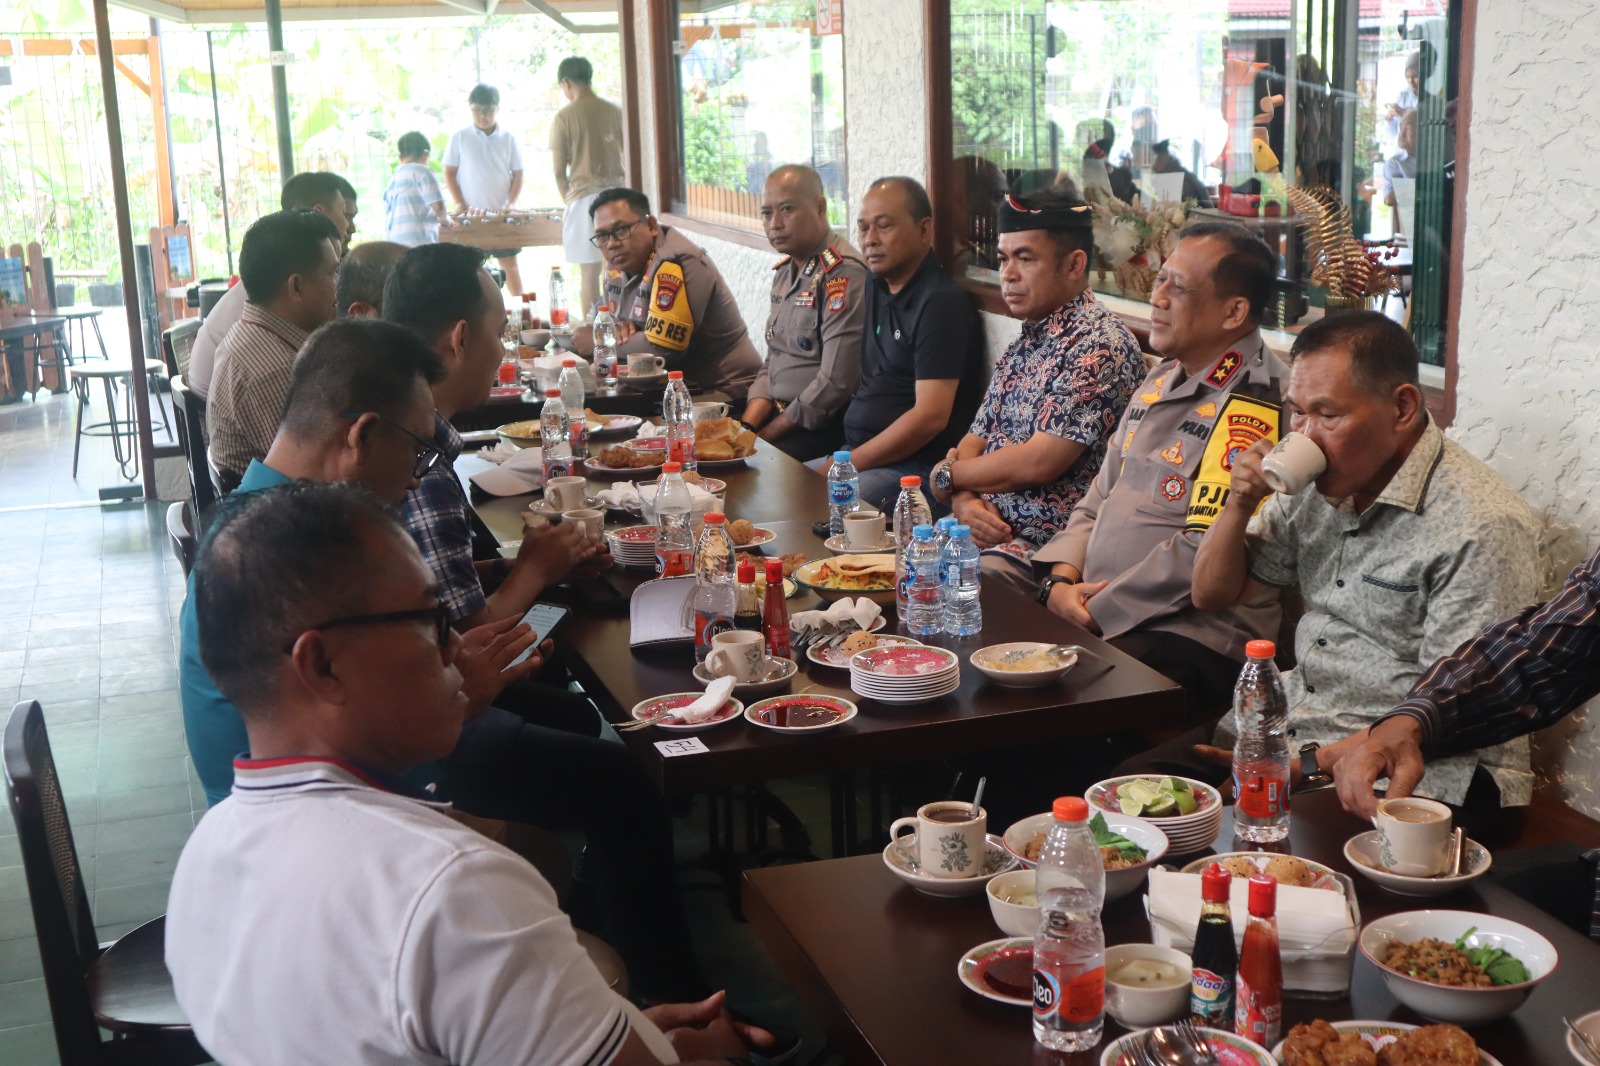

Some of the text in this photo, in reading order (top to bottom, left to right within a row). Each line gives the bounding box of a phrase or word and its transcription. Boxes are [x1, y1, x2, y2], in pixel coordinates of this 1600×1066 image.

[826, 277, 847, 288] POLDA
[665, 322, 687, 342] RES
[1178, 420, 1210, 441] POLRI
[1232, 416, 1267, 432] POLDA
[1192, 976, 1230, 993] edaap
